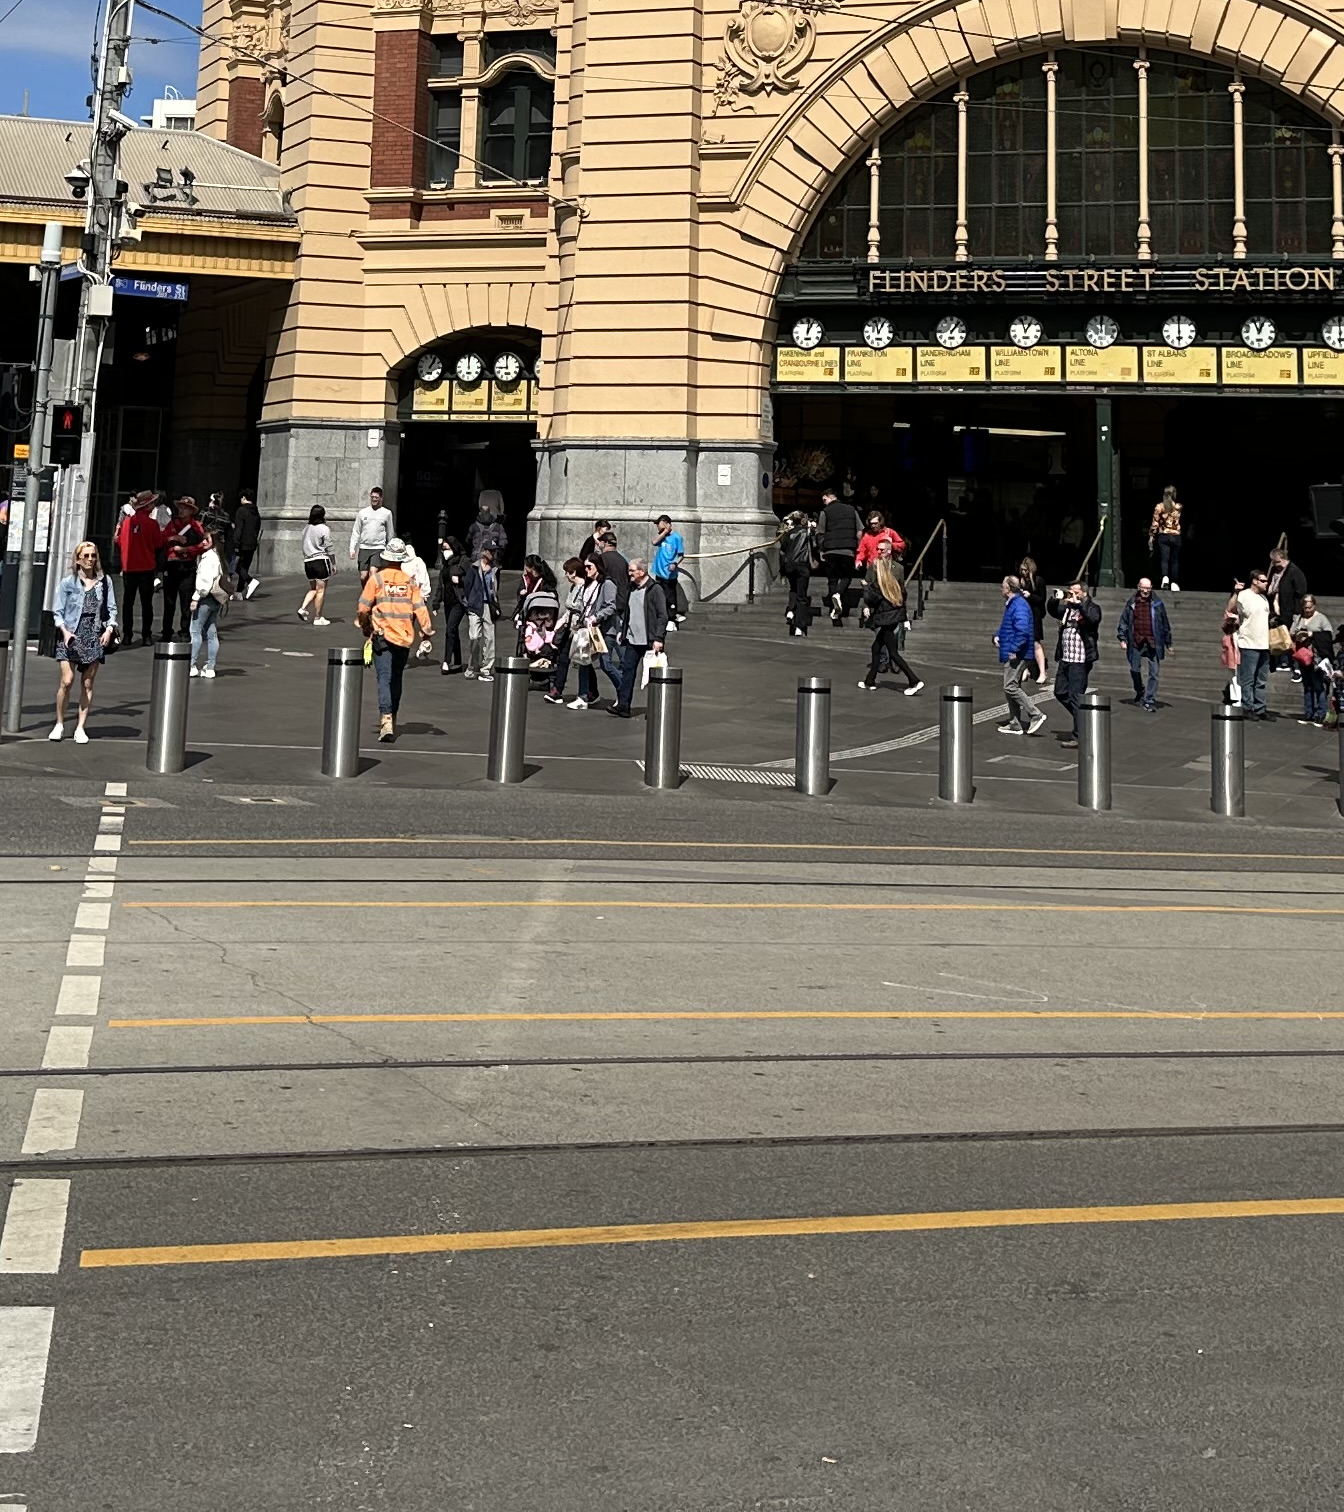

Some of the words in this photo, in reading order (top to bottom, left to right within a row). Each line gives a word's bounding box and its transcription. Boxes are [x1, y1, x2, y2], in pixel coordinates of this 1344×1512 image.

[869, 269, 1006, 292] FLINDERS
[1046, 268, 1155, 292] STREET
[1195, 267, 1334, 291] STATION
[134, 279, 172, 294] Flinders
[174, 284, 185, 294] St
[846, 349, 887, 358] FRANKSTON
[920, 349, 971, 357] SANDRINGHAM
[994, 349, 1049, 357] WILLIAMSTOWN
[1070, 348, 1099, 357] ALTONA
[1146, 349, 1156, 357] ST
[1158, 349, 1187, 357] ALBANS
[1225, 350, 1292, 359] BROADMEADOWS
[1307, 351, 1339, 359] UPFIELD
[920, 359, 936, 367] LINE
[994, 359, 1010, 367] LINE
[1070, 358, 1086, 366] LINE
[1146, 360, 1163, 368] LINE
[1226, 360, 1243, 369] LINE
[1307, 361, 1324, 369] LINE
